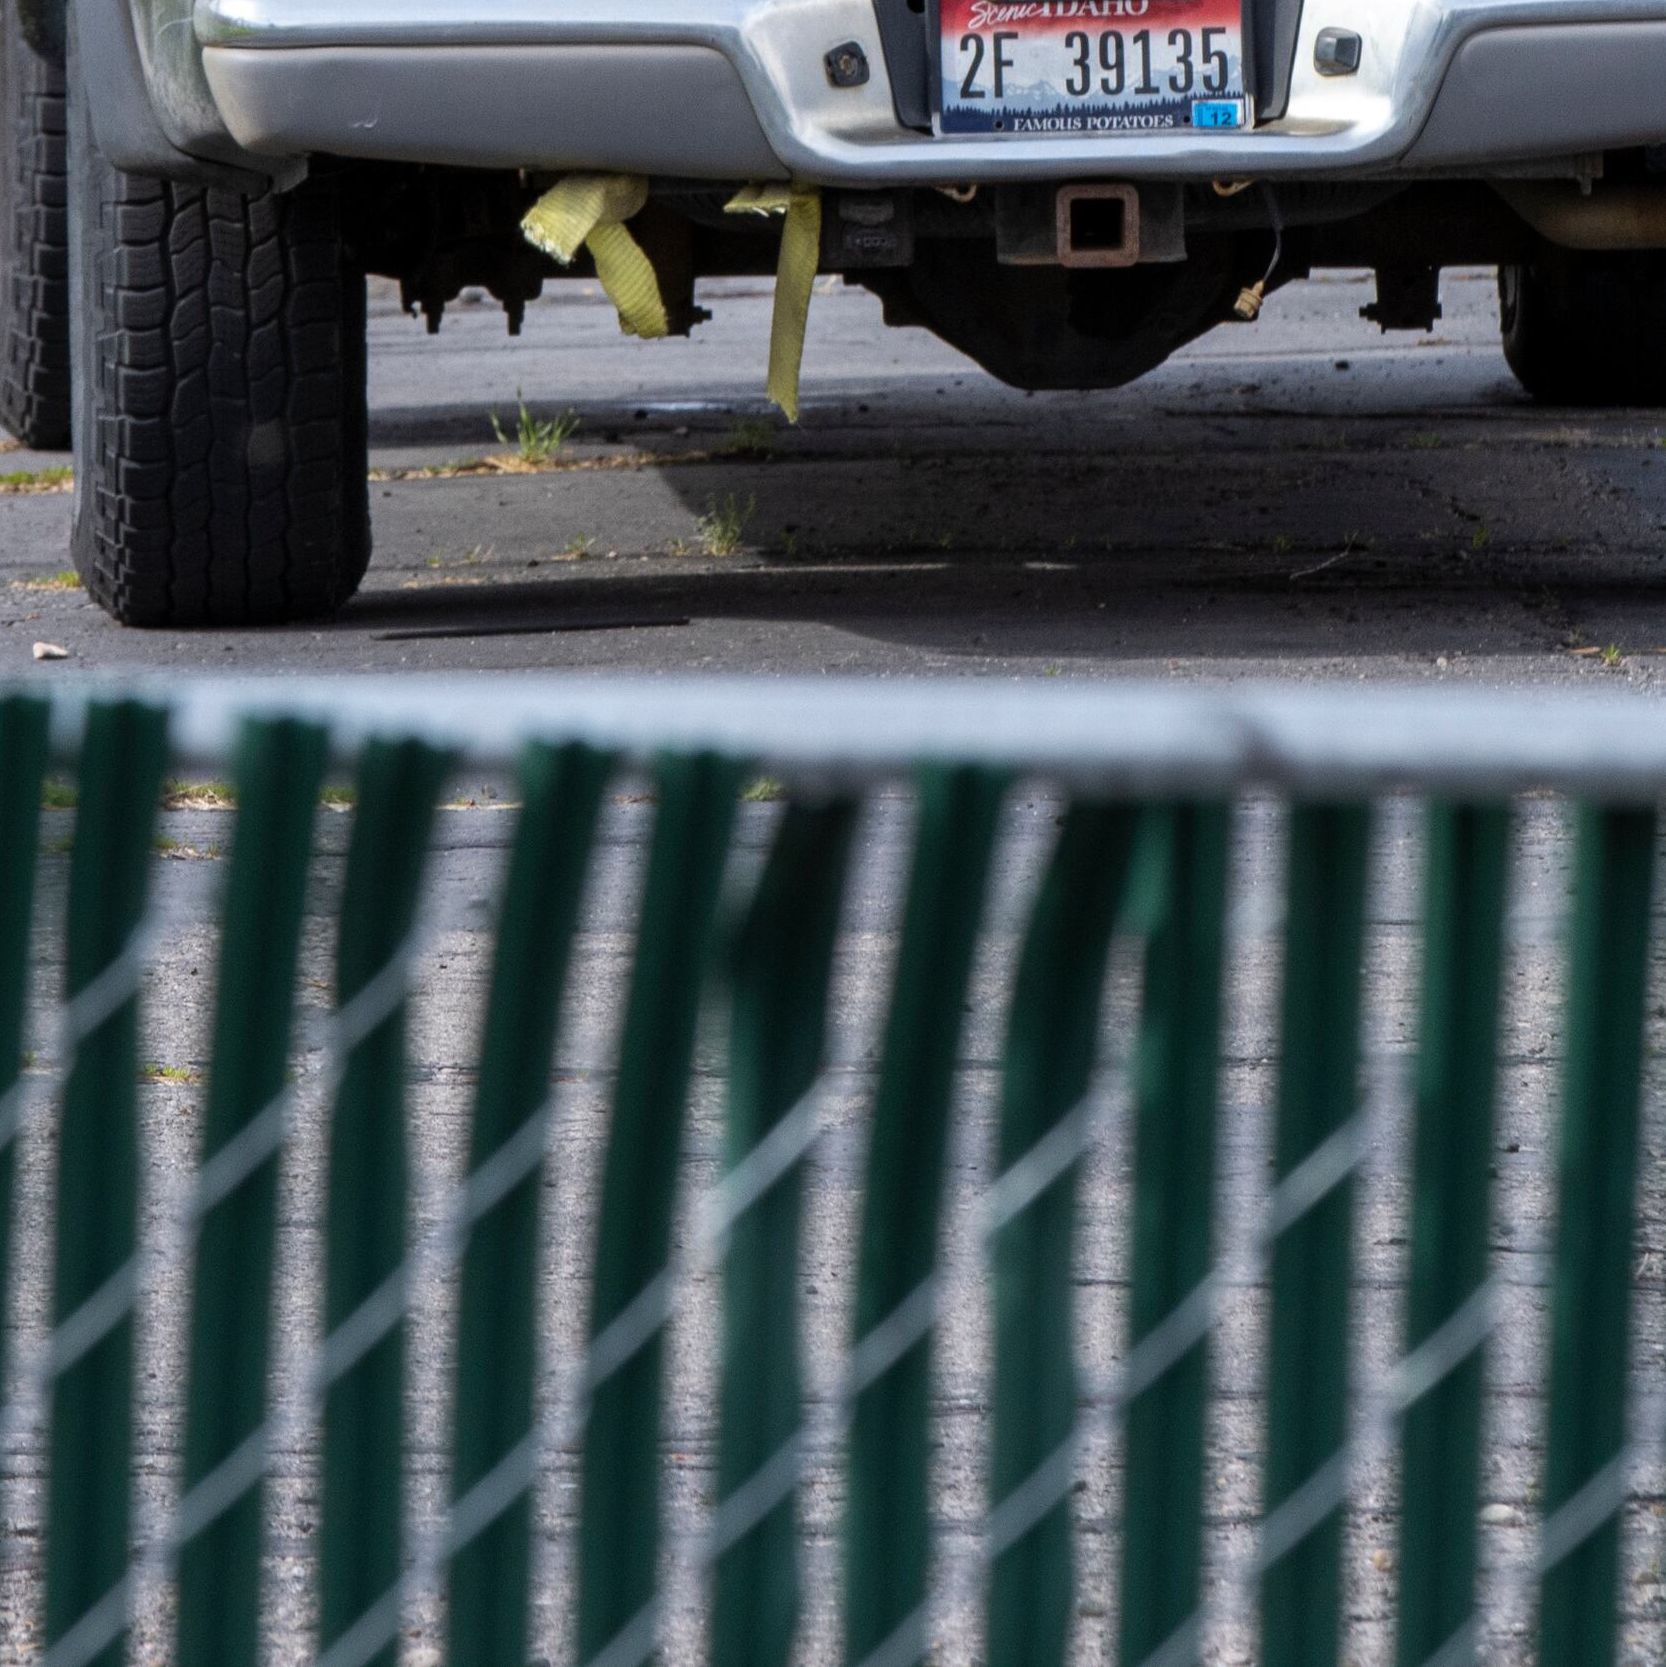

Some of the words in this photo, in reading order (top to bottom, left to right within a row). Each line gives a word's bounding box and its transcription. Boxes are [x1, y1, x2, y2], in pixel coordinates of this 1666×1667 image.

[967, 0, 1042, 29] Scenic
[960, 31, 1019, 99] 2F
[1065, 26, 1229, 96] 39135
[1014, 115, 1082, 131] FAMOUS
[1086, 114, 1174, 130] POTATOES
[1210, 111, 1232, 126] 12
